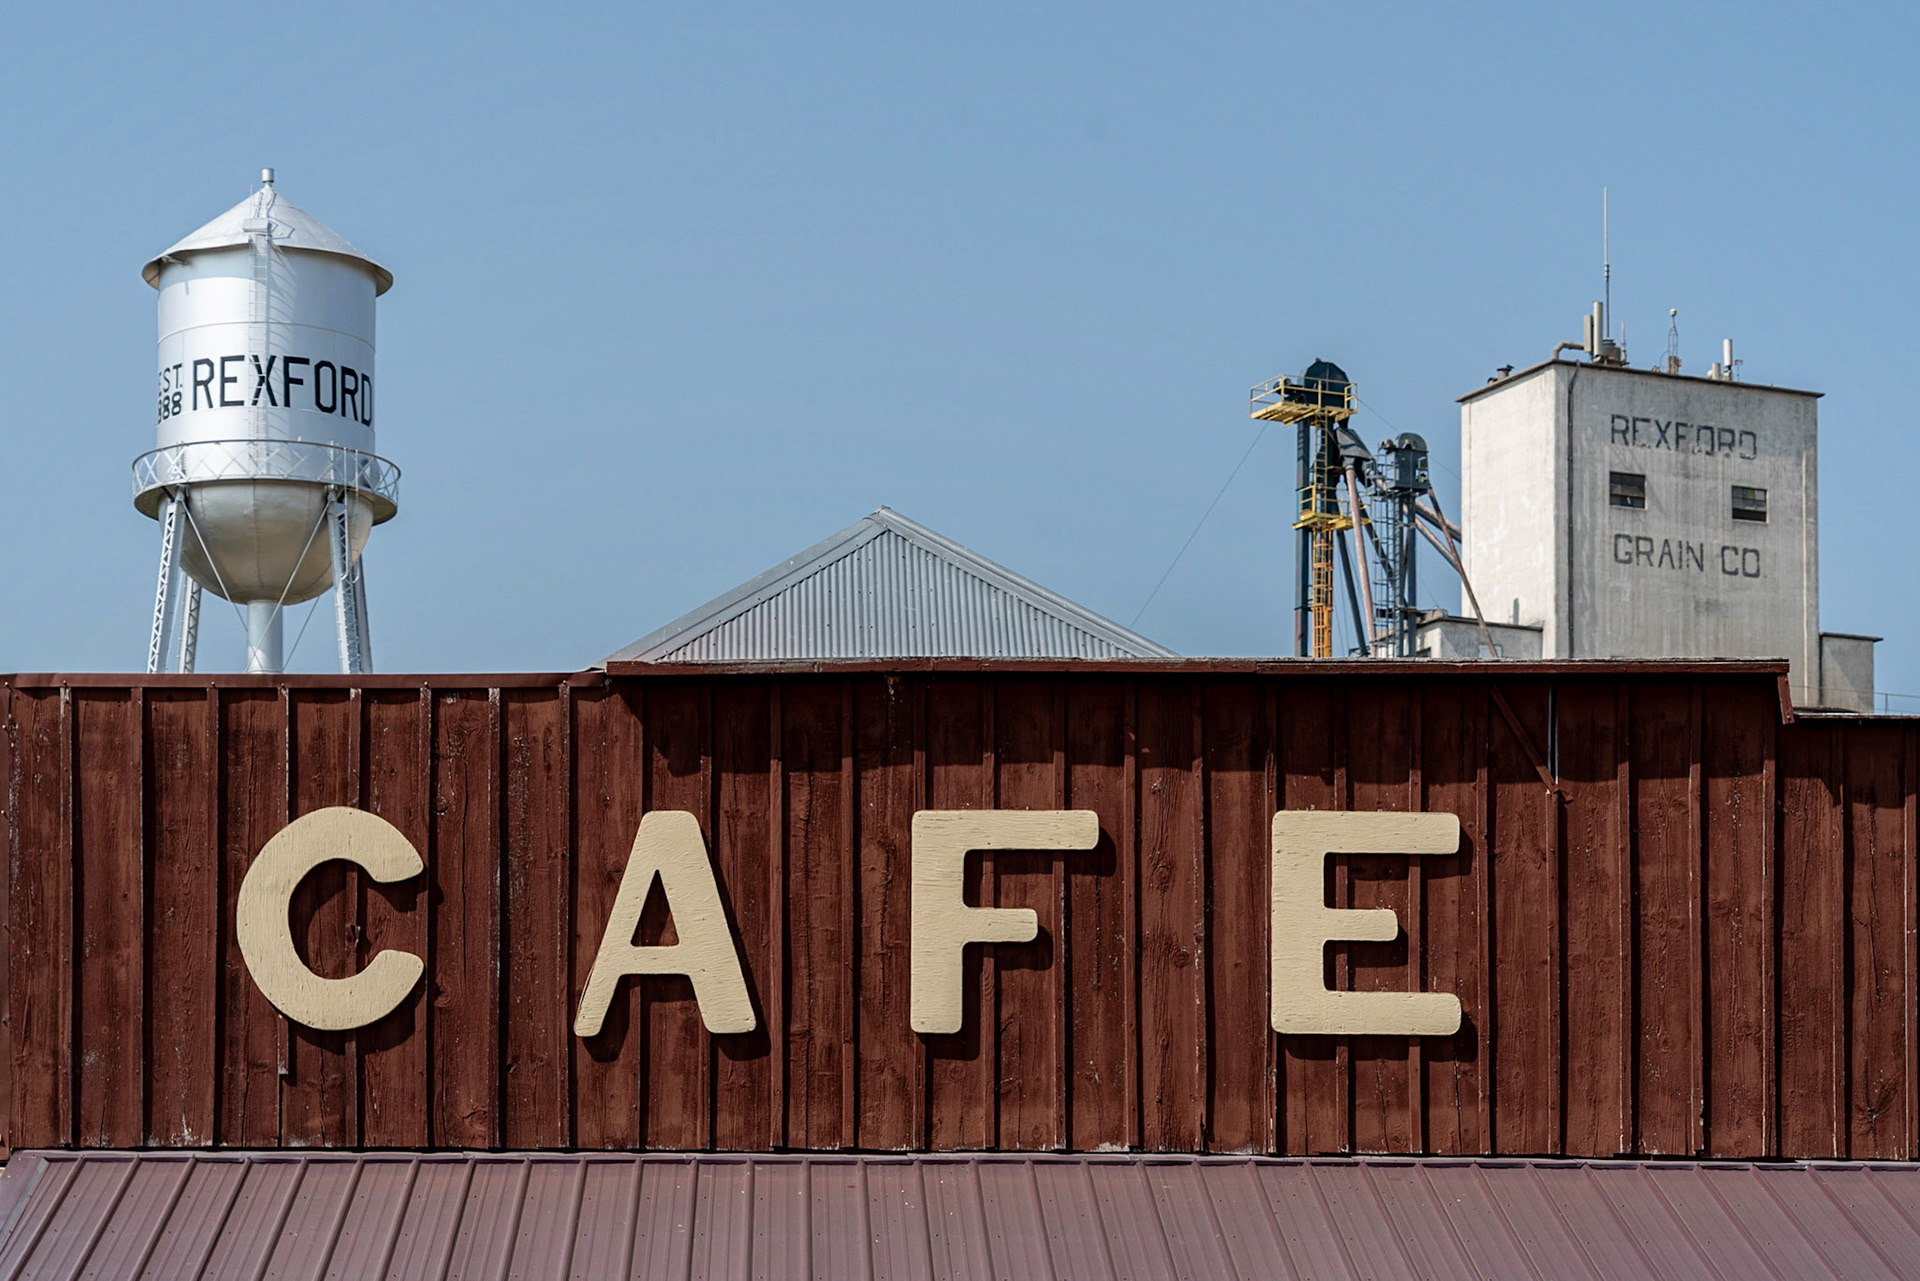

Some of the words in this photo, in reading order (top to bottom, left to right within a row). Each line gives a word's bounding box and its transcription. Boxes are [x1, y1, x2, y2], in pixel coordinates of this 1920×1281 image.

[193, 355, 373, 427] REXFORD
[1610, 414, 1758, 461] REXFORD
[1614, 533, 1704, 572] GRAIN
[1721, 545, 1761, 578] CO
[236, 806, 1462, 1036] CAFE
